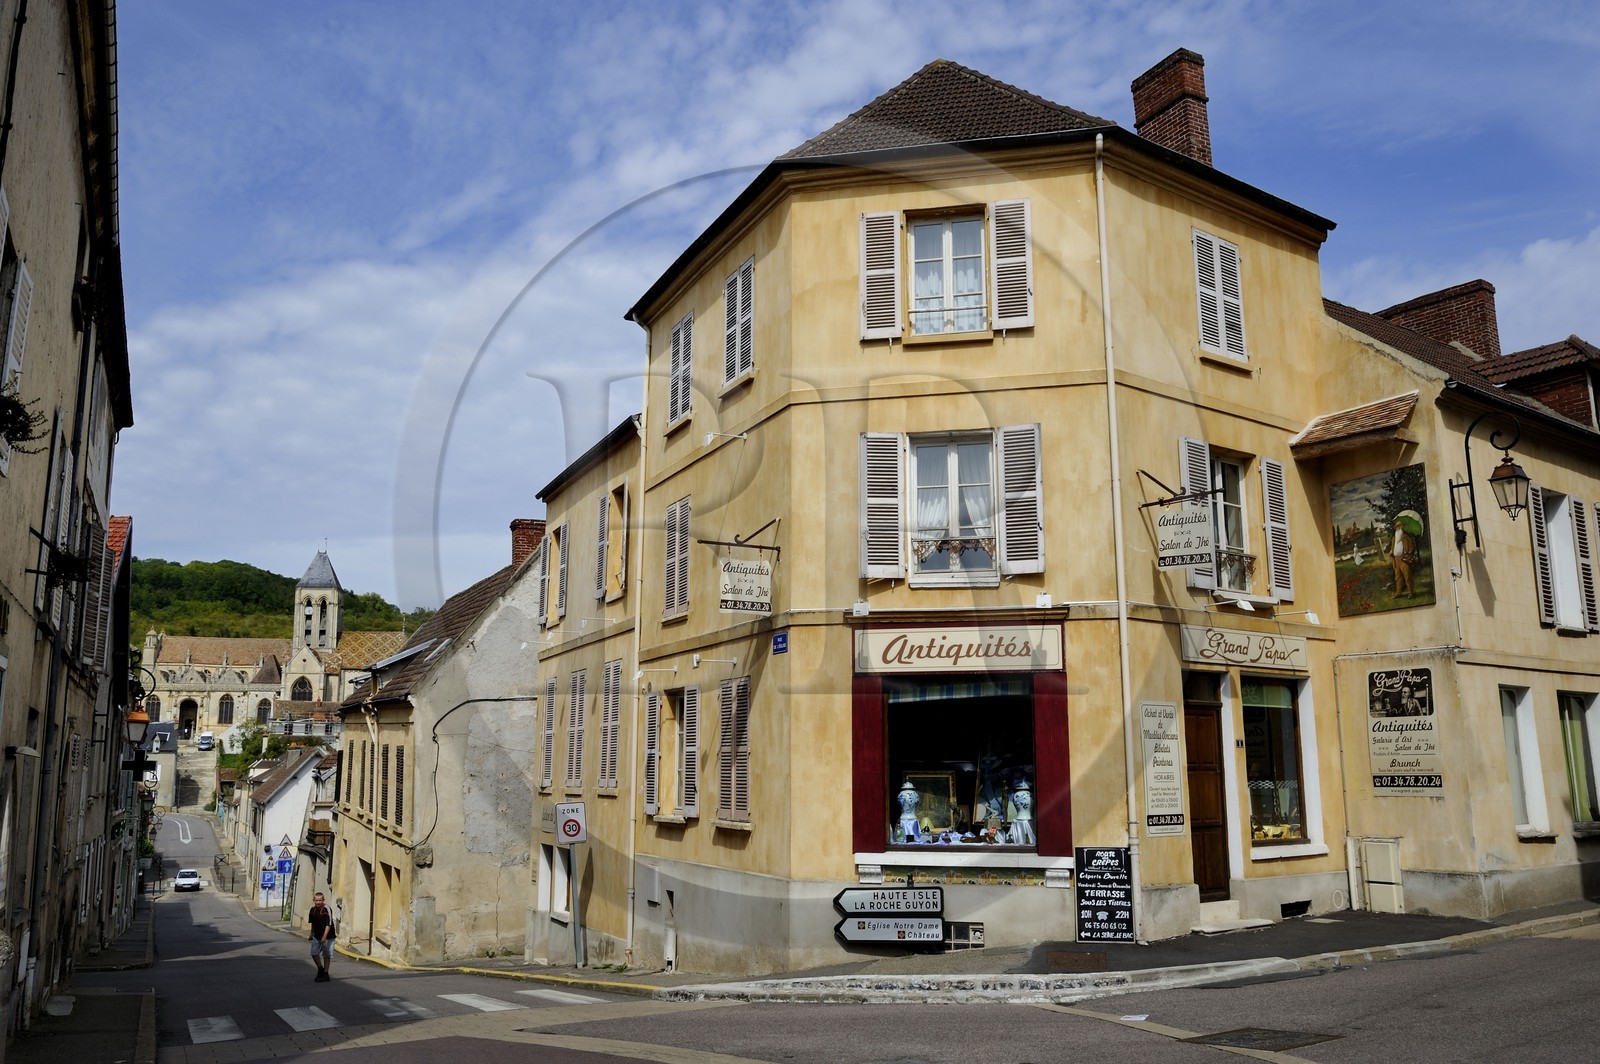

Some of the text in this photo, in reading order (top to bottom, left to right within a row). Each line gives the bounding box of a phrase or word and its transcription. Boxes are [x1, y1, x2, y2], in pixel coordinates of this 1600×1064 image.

[1158, 512, 1207, 528] Antiquités
[1159, 536, 1209, 552] Salon de Thé
[1166, 554, 1211, 566] 01.34.78.20.24
[722, 562, 770, 577] Antiquités
[722, 584, 769, 598] Salon de Thé
[726, 601, 770, 611] 01.34.78.20.24
[882, 634, 1031, 666] Antiquités
[1200, 628, 1300, 664] Grand Papa
[1372, 669, 1427, 696] Grand Papa
[1372, 720, 1433, 736] Antiquités
[1424, 743, 1435, 751] Thé
[1390, 759, 1421, 768] Brunch
[1382, 776, 1441, 786] 01.34.78.20.24
[566, 824, 577, 832] 30
[873, 891, 938, 900] HAUTE ISLE
[1085, 890, 1125, 898] TERRASSE
[867, 922, 890, 930] Église
